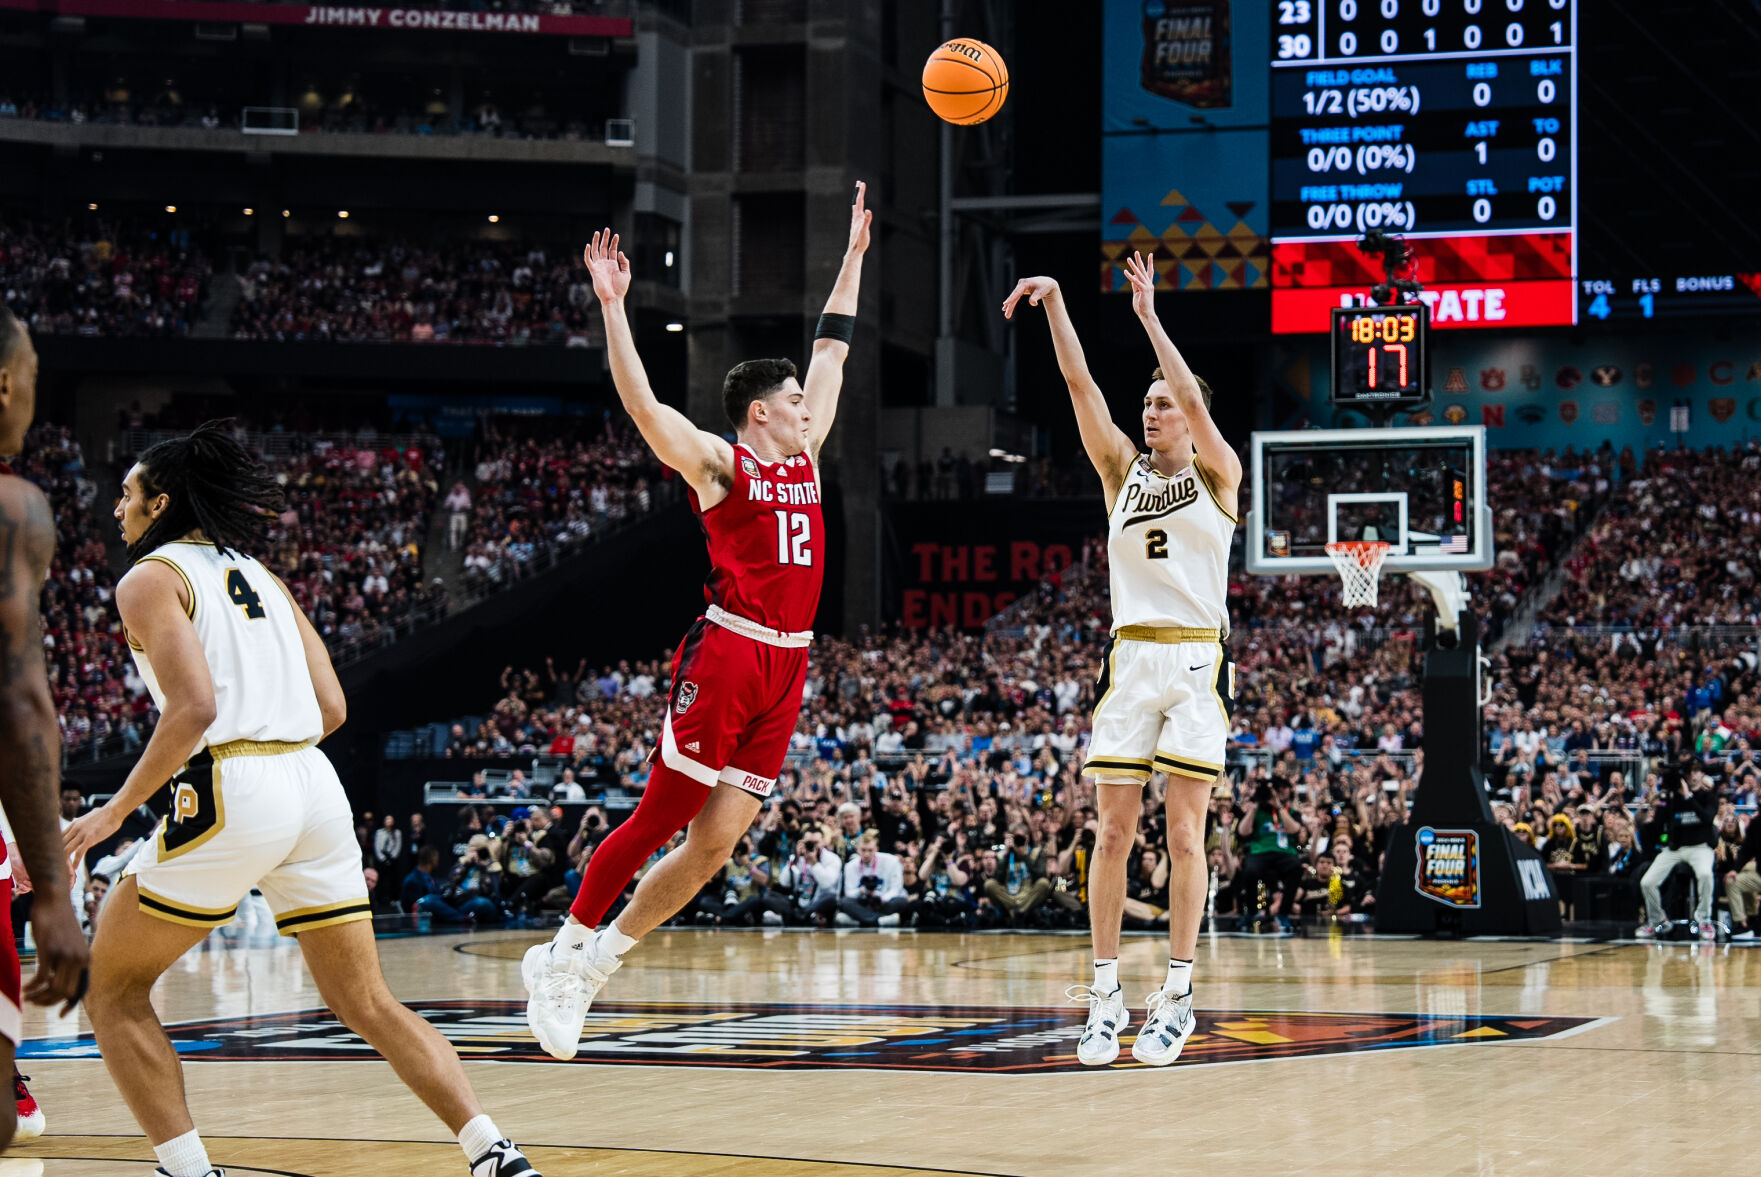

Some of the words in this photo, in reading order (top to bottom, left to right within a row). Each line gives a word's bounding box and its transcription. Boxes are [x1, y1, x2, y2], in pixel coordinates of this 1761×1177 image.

[306, 6, 381, 24] JIMMY
[389, 9, 540, 32] CONZELMAN
[1278, 1, 1311, 24] 23
[1339, 0, 1357, 21] 0
[1381, 0, 1398, 19] 0
[1155, 17, 1213, 40] FINAL
[1278, 34, 1311, 58] 30
[1339, 31, 1357, 55] 0
[1381, 29, 1398, 53] 0
[1424, 27, 1436, 51] 1
[1464, 25, 1482, 49] 0
[1506, 23, 1524, 47] 0
[1550, 21, 1562, 44] 1
[1154, 41, 1212, 64] FOUR
[1306, 70, 1350, 87] FIELD
[1351, 67, 1398, 85] GOAL
[1466, 62, 1498, 79] REB
[1530, 59, 1562, 76] BLK
[1303, 89, 1343, 115] 1/2
[1347, 85, 1420, 118] (50%)
[1473, 82, 1491, 107] 0
[1537, 79, 1555, 104] 0
[1299, 127, 1351, 144] THREE
[1352, 124, 1404, 142] POINT
[1464, 120, 1500, 138] AST
[1532, 117, 1560, 134] TO
[1307, 146, 1352, 172] 0/0
[1356, 143, 1415, 175] (0%)
[1475, 141, 1487, 165] 1
[1537, 137, 1555, 162] 0
[1300, 185, 1339, 202] FREE
[1340, 182, 1403, 201] THROW
[1465, 178, 1498, 196] STL
[1527, 175, 1566, 194] POT
[1307, 203, 1352, 229] 0/0
[1356, 200, 1415, 232] (0%)
[1473, 198, 1491, 223] 0
[1537, 195, 1555, 220] 0
[1582, 280, 1616, 295] TOL
[1632, 278, 1661, 293] FLS
[1676, 275, 1735, 292] BONUS
[1404, 289, 1506, 322] TATE
[1587, 293, 1612, 320] 4
[1639, 293, 1654, 318] 1
[1352, 316, 1415, 343] 18:03
[1368, 344, 1407, 389] 17
[749, 479, 773, 502] NC
[776, 482, 818, 505] STATE
[1122, 477, 1198, 513] Purdue
[774, 510, 812, 567] 12
[1145, 528, 1168, 559] 2
[912, 543, 997, 582] THE
[224, 567, 266, 620] 4
[742, 775, 770, 793] PACK
[173, 782, 199, 825] P
[1425, 844, 1466, 860] FINAL
[1425, 860, 1466, 876] FOUR
